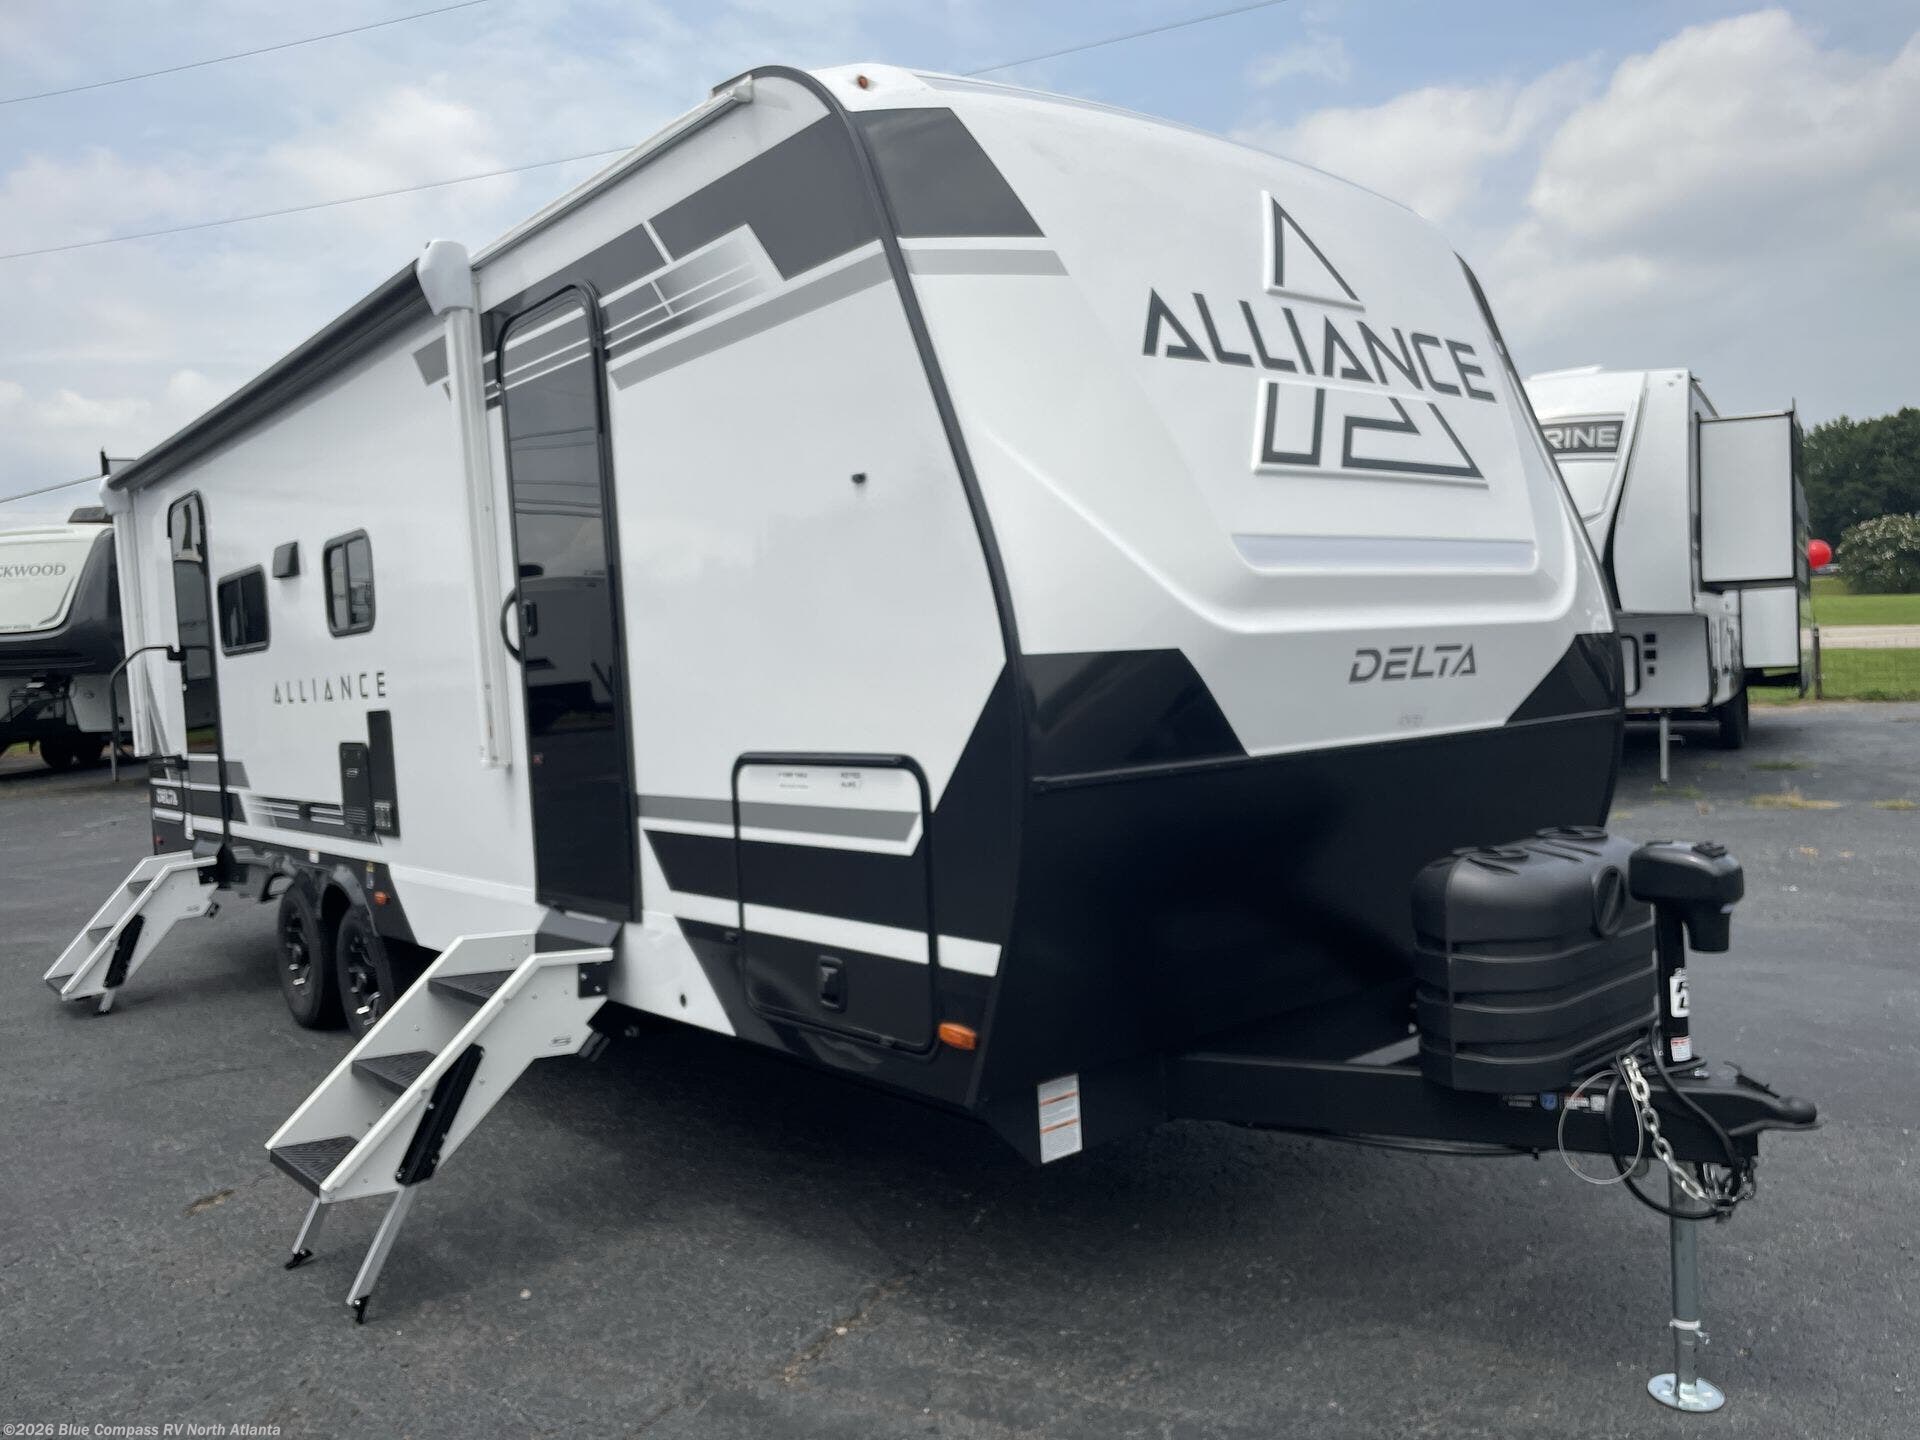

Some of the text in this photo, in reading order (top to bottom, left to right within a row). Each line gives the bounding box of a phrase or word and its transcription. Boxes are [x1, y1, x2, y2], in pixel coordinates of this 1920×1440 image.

[1143, 287, 1496, 402] ALLIANCE
[1543, 426, 1618, 449] RINE
[1349, 644, 1476, 684] DELTA
[274, 671, 386, 704] ALLIANCE
